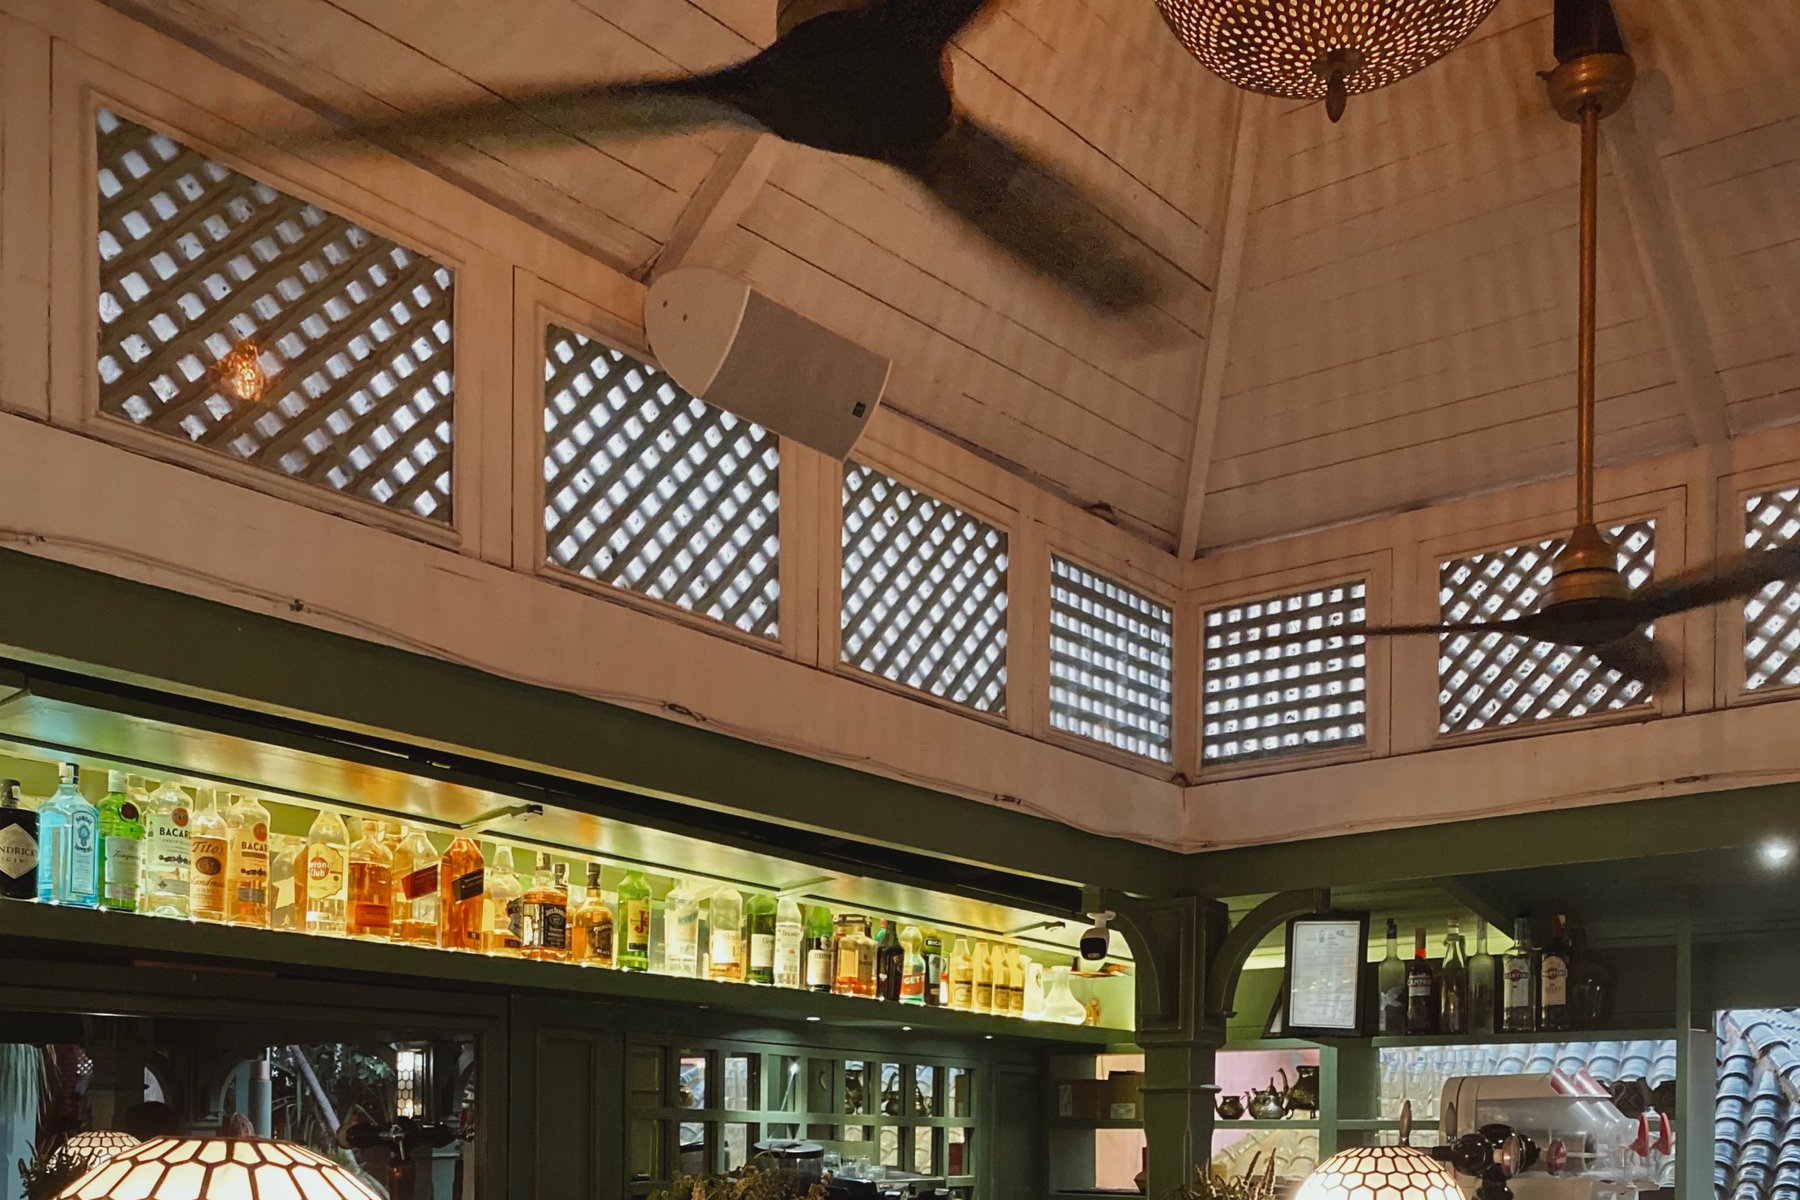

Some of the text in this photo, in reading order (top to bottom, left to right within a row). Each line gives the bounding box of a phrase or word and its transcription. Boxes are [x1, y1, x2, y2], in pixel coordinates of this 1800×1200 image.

[191, 841, 224, 855] Tito's
[310, 868, 326, 877] Club
[1504, 971, 1530, 980] MARTINI
[1542, 968, 1567, 977] MARTINI
[904, 976, 920, 985] GET
[1407, 978, 1432, 988] CAMPARI
